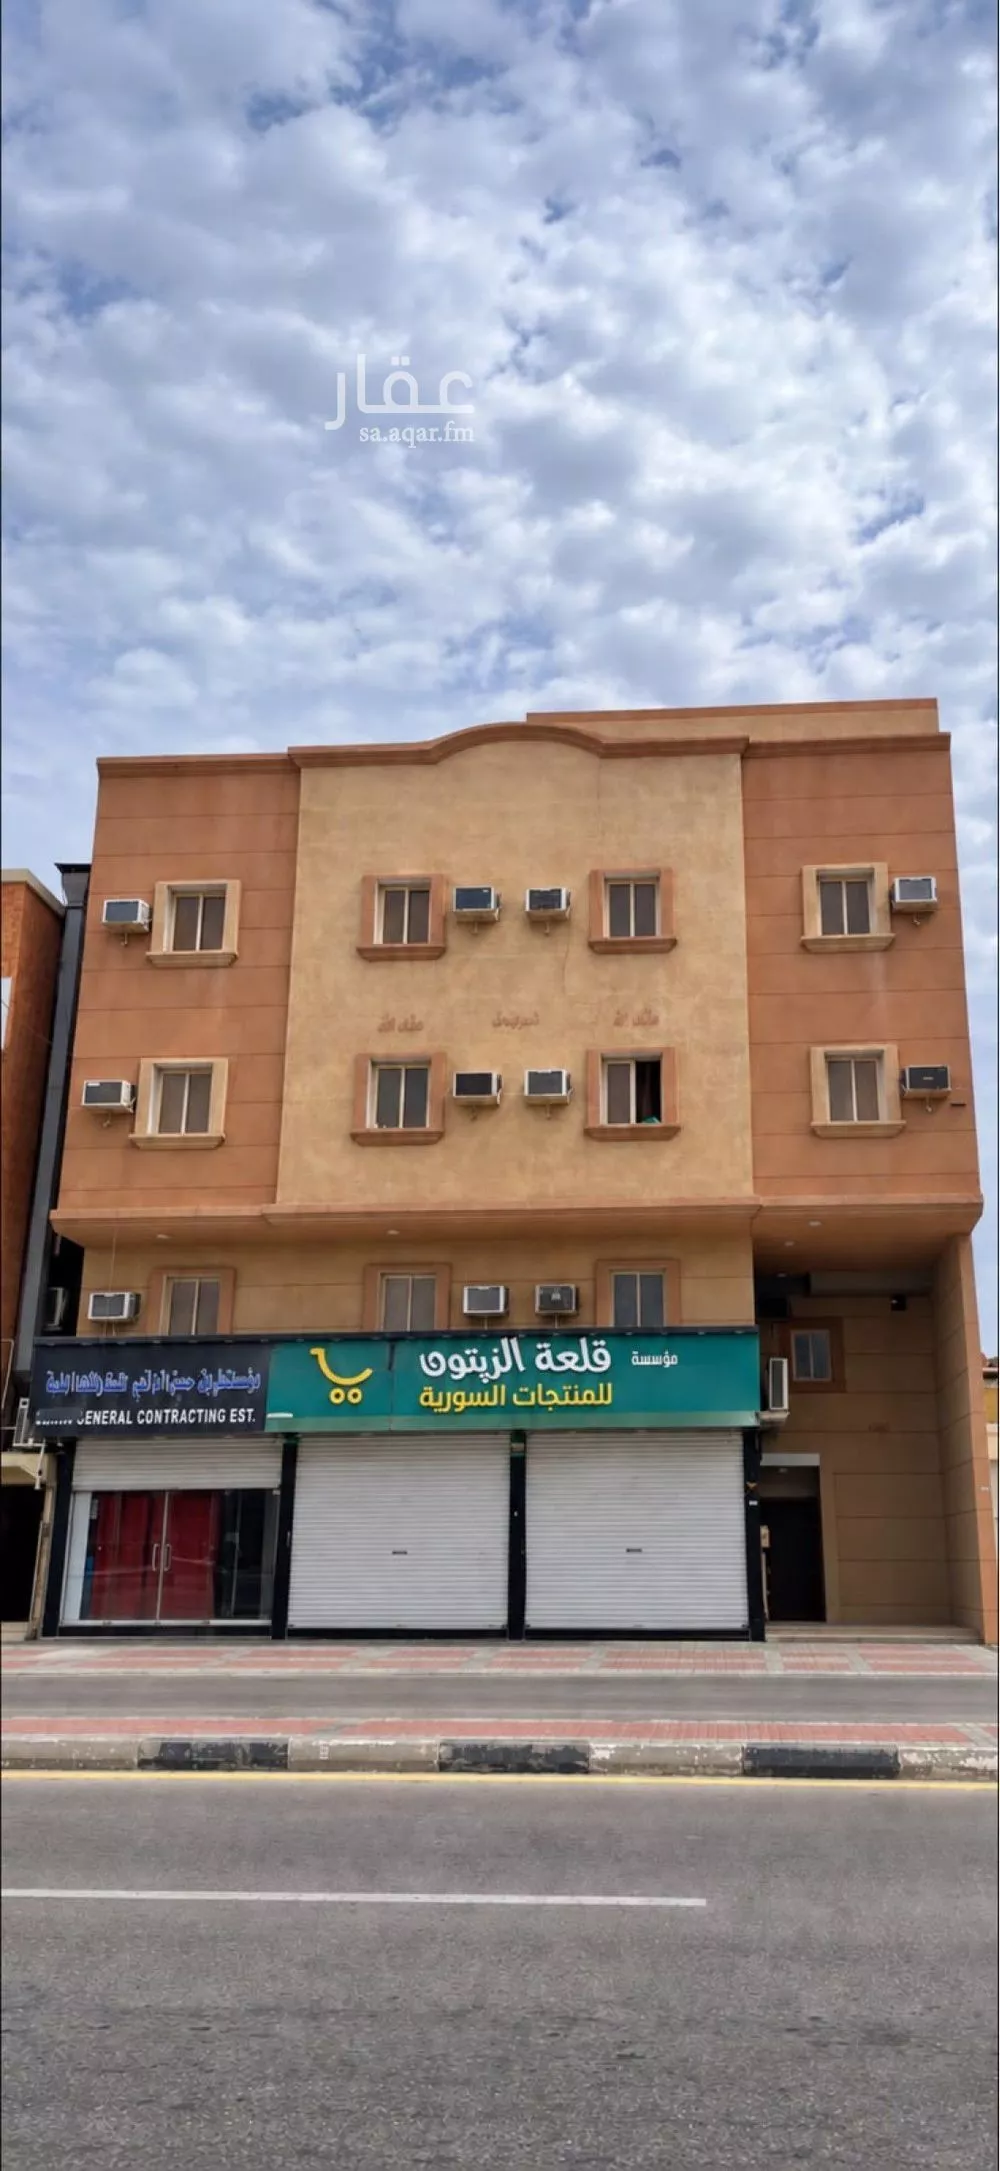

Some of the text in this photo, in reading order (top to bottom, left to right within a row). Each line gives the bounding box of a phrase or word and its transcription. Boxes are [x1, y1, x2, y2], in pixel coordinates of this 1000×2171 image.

[534, 1336, 612, 1373] قلعة
[631, 1349, 679, 1368] مؤسسة
[419, 1382, 613, 1413] للمنتجات السورية
[137, 1408, 226, 1425] CONTRACTING
[230, 1407, 256, 1423] EST.
